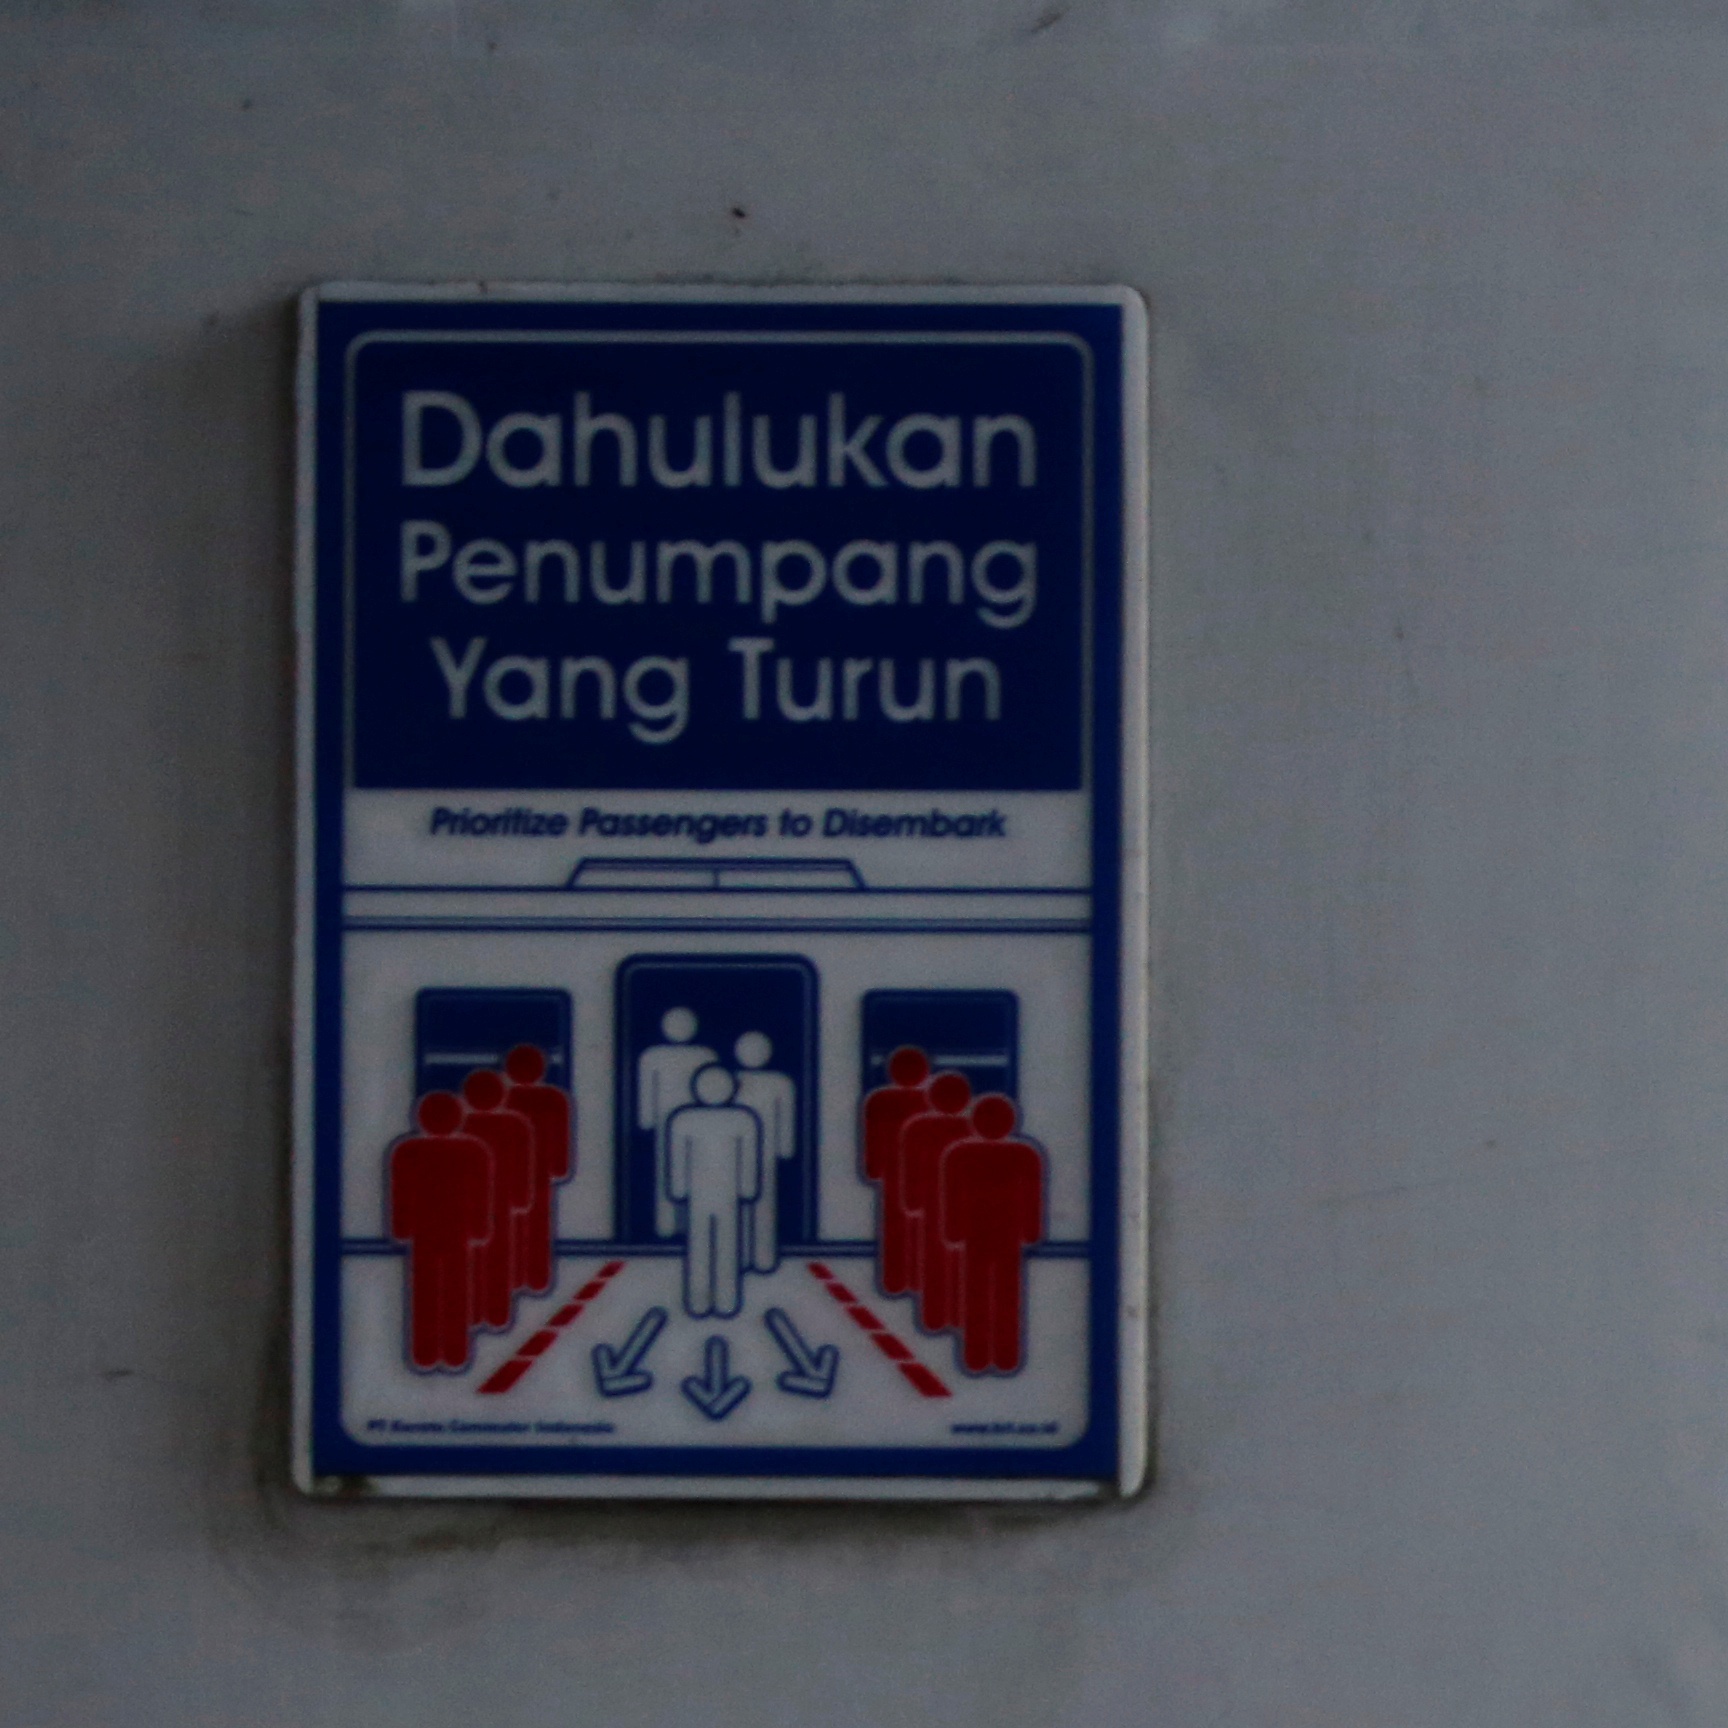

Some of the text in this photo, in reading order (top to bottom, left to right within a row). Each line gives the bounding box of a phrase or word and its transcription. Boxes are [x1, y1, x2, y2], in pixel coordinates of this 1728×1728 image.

[401, 391, 1036, 489] Dahulukan
[401, 520, 1036, 629] Penumpang
[431, 637, 1000, 744] Yang Turun
[429, 806, 1006, 845] Prioritize Passengers to Disembark
